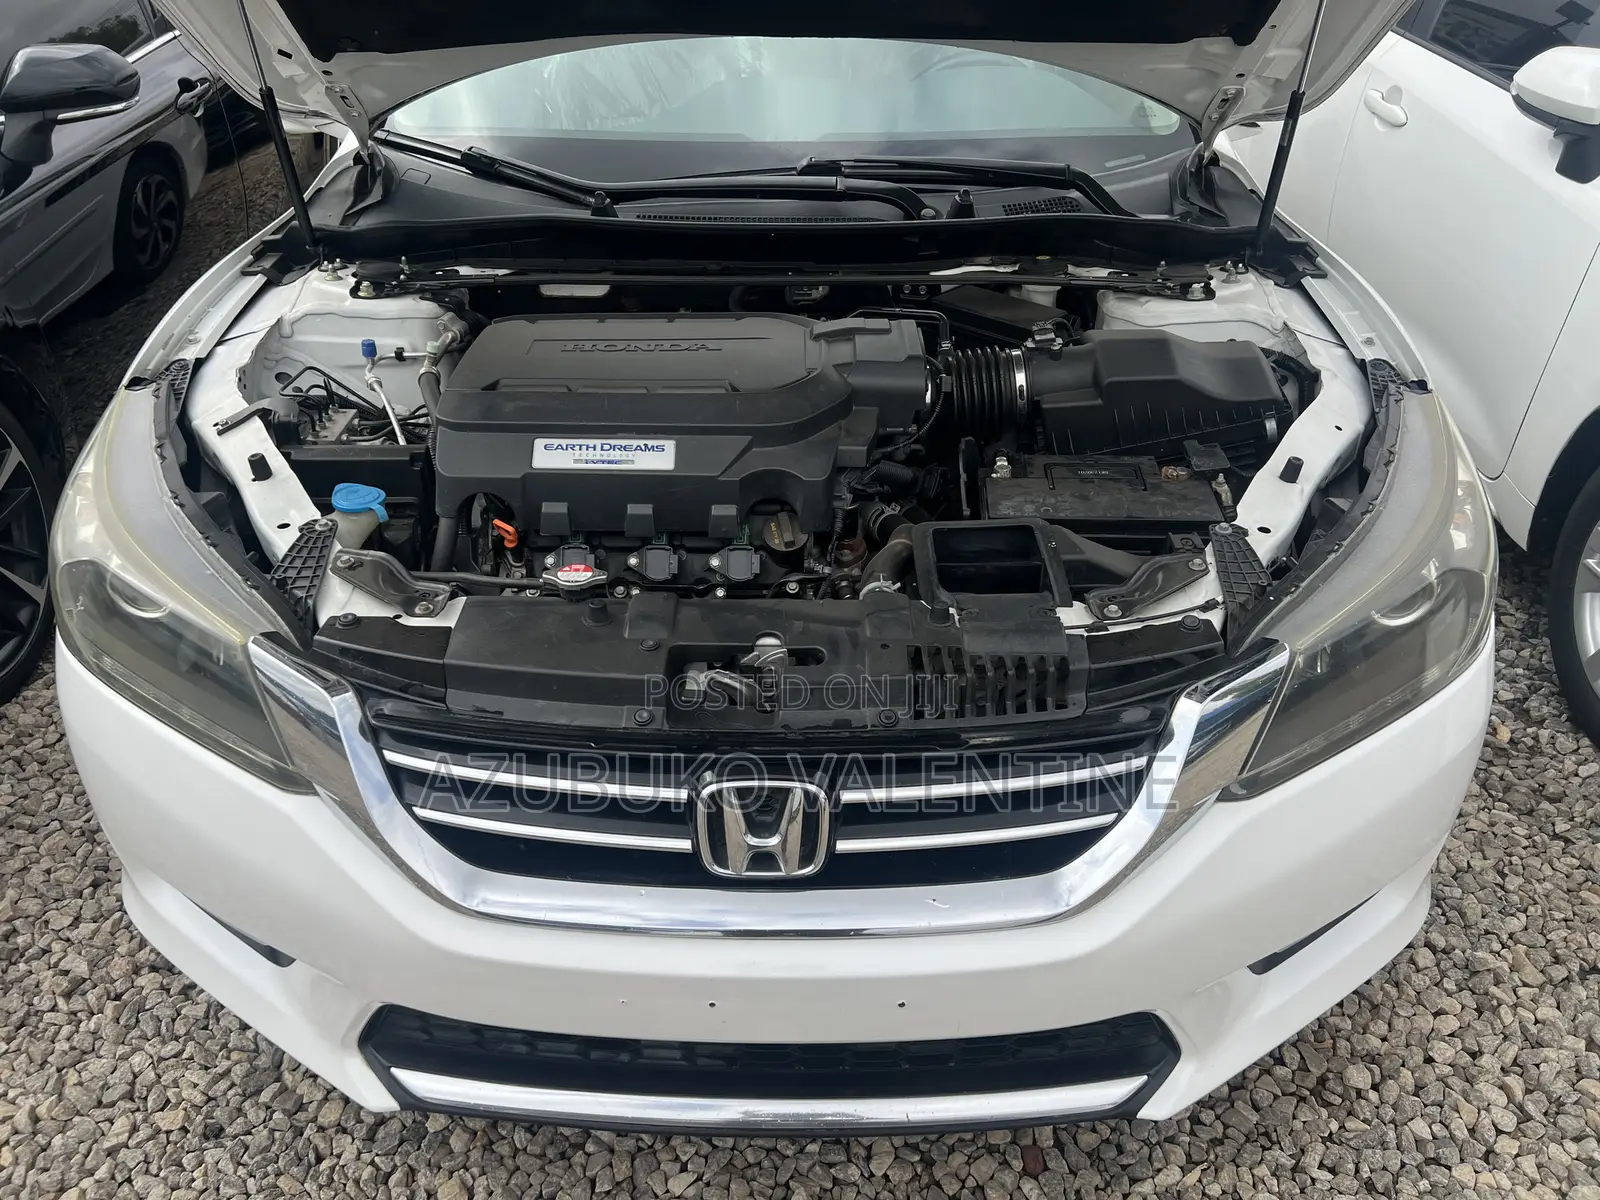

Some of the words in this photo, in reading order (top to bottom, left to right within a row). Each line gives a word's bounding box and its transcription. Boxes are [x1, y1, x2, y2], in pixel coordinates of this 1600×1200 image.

[561, 343, 722, 352] HONDA
[544, 444, 596, 452] EARTH
[600, 443, 665, 453] DREAMS
